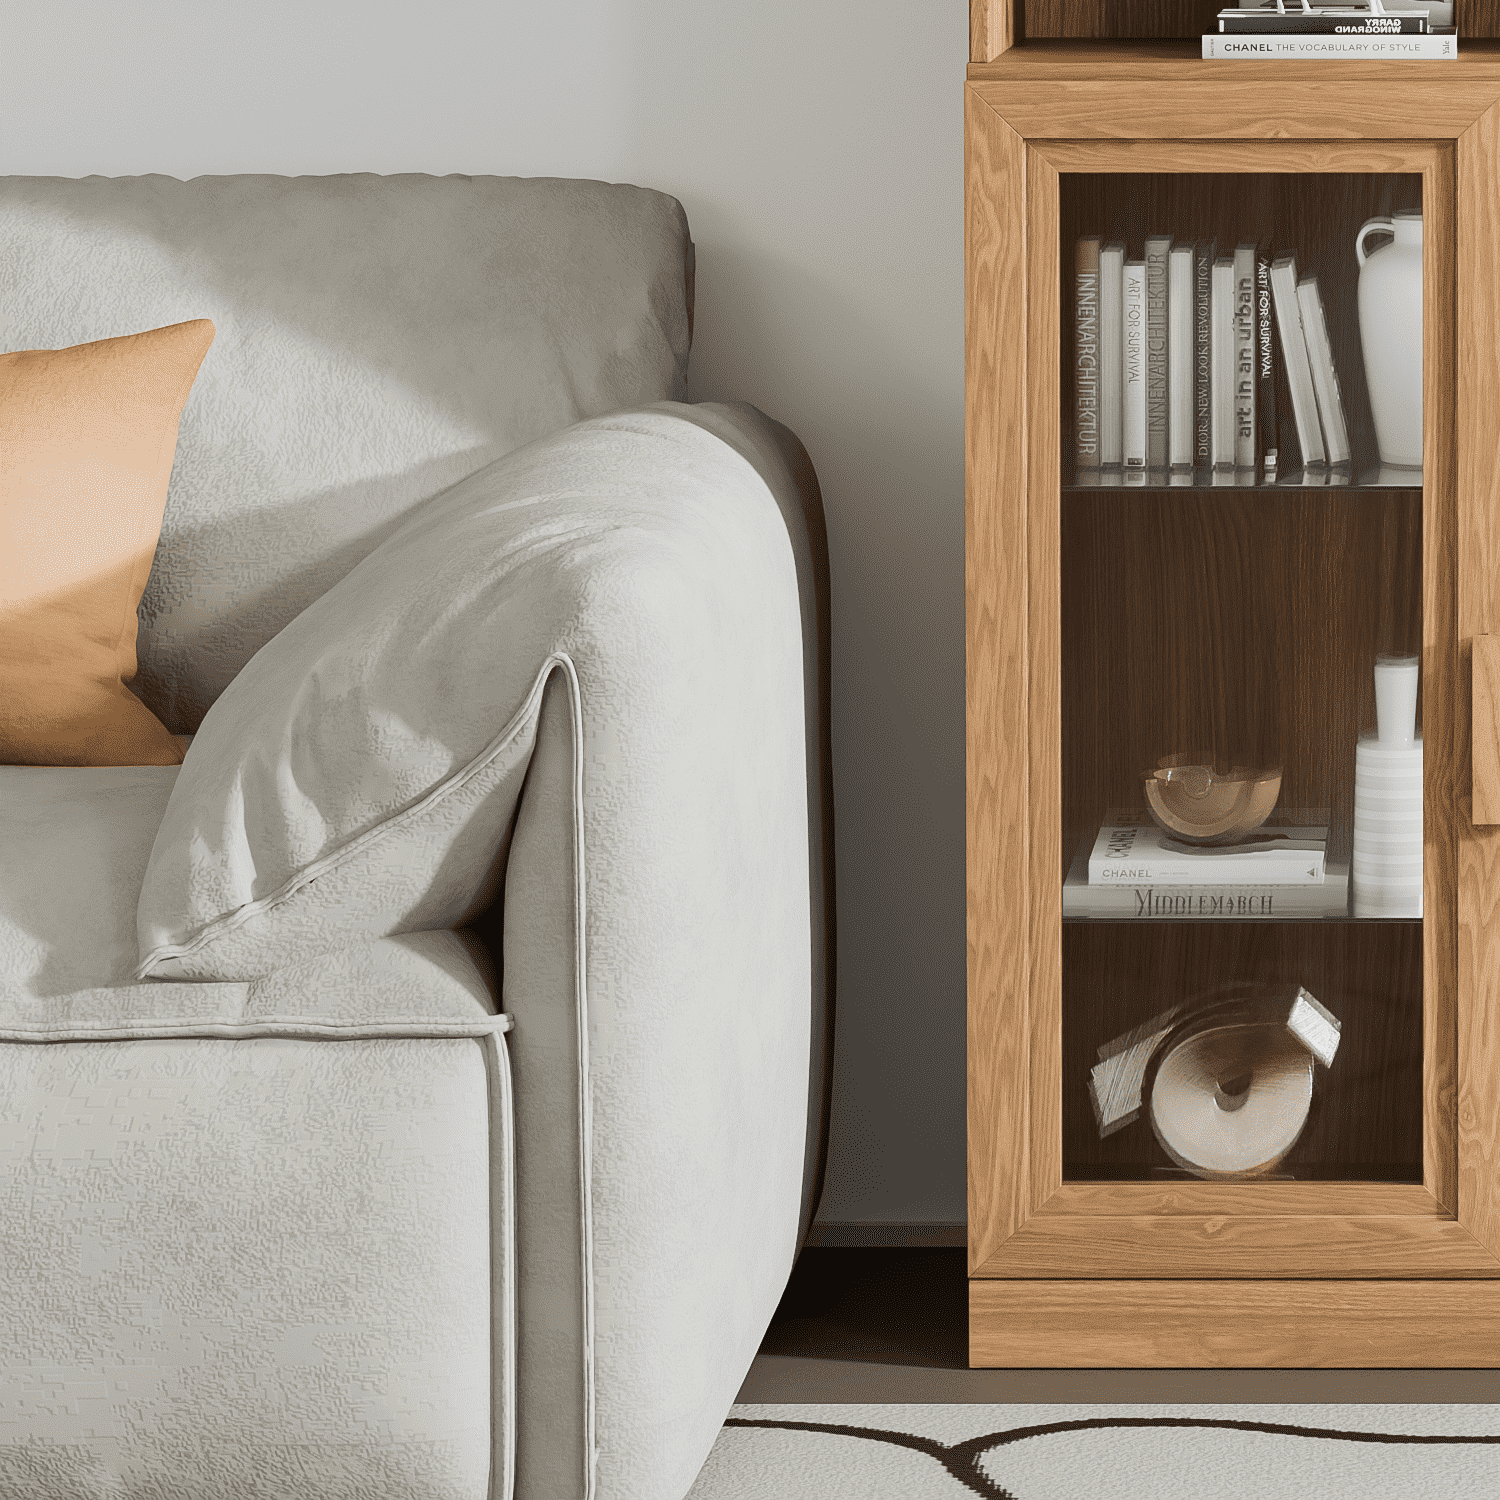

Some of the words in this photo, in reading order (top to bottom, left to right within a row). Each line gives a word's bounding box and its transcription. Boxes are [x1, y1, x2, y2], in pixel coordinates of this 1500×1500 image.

[1224, 44, 1273, 52] CHANEL
[1442, 40, 1450, 55] Yale
[1258, 262, 1268, 286] ART
[1128, 277, 1140, 299] ART
[1235, 277, 1252, 341] urban
[1259, 290, 1269, 316] FOR
[1128, 304, 1141, 327] FOR
[1128, 332, 1140, 384] SURVIVAL
[1239, 348, 1251, 373] an
[1260, 320, 1271, 377] SURVIVAL
[1077, 273, 1096, 454] INNENARCHITEKTUR
[1236, 380, 1251, 399] in
[1237, 407, 1252, 438] art
[1102, 869, 1152, 878] CHANEL
